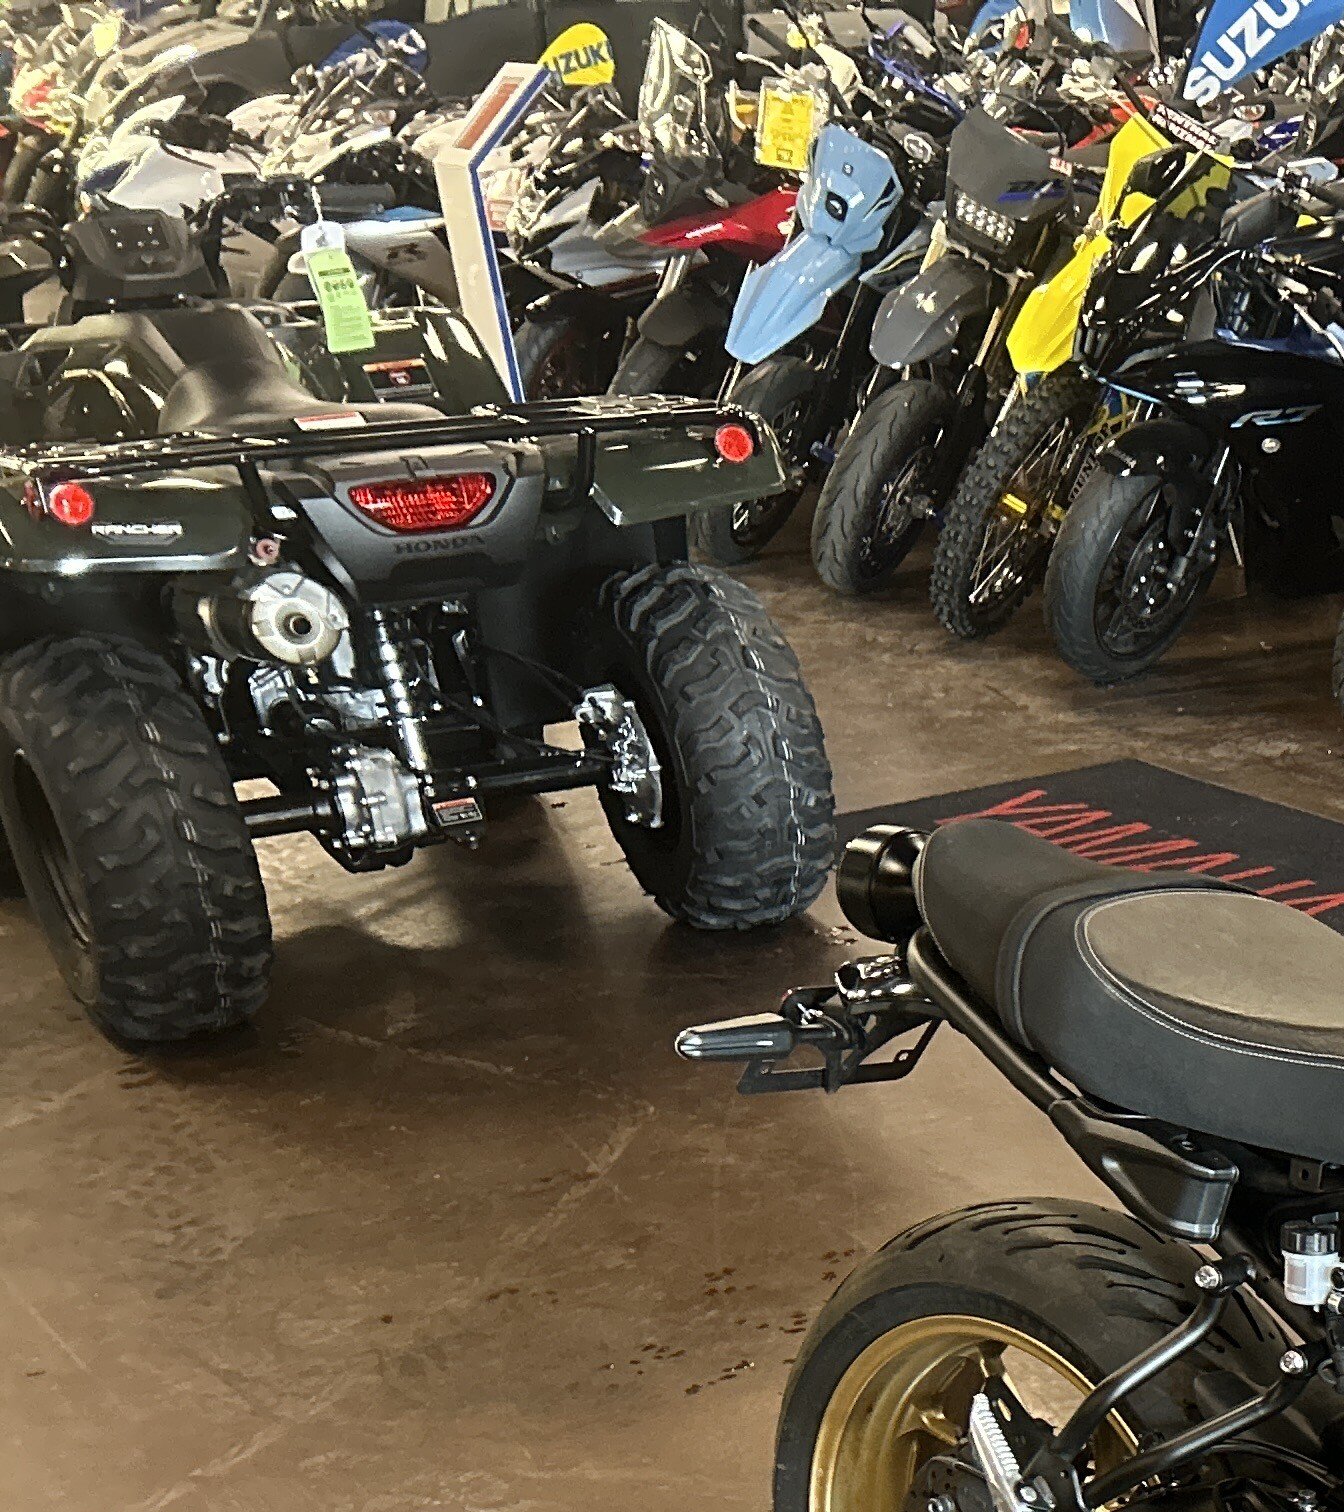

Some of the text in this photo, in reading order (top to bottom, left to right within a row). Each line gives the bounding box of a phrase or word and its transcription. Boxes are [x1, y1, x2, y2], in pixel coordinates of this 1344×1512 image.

[543, 41, 613, 78] UZUKI
[1184, 0, 1312, 107] SUZU
[91, 523, 184, 536] RANCHER
[395, 533, 488, 556] HONDA
